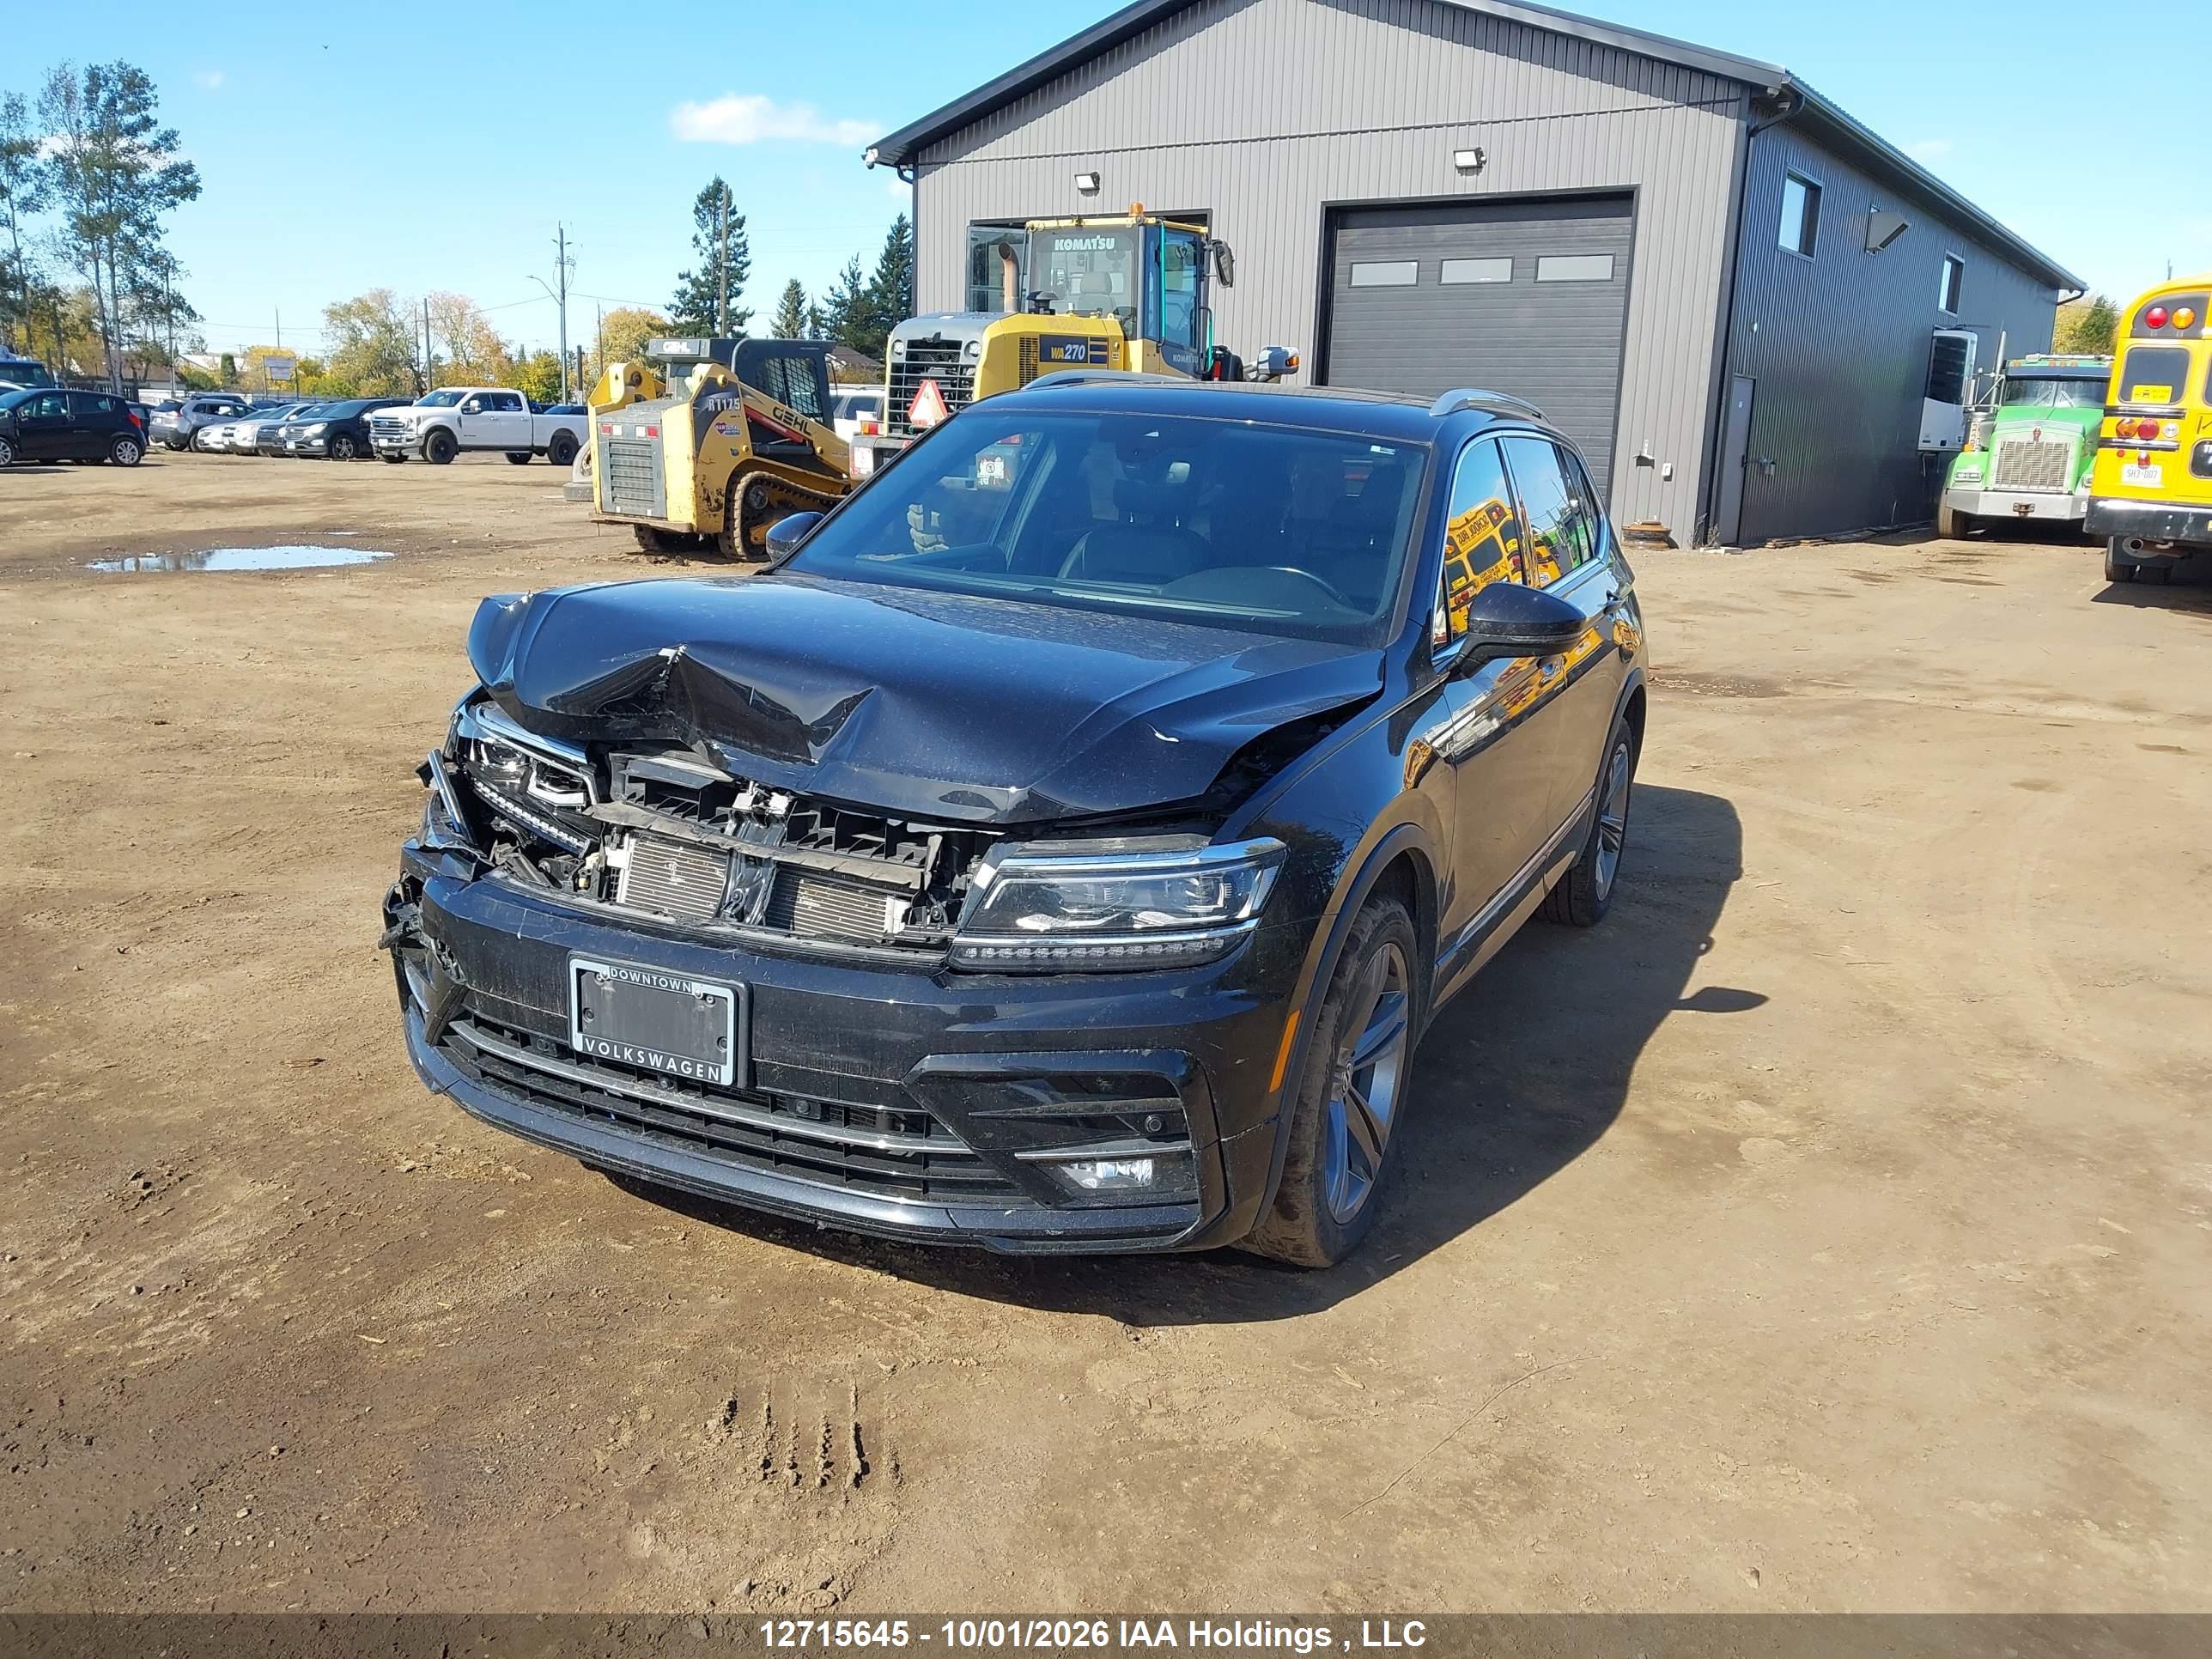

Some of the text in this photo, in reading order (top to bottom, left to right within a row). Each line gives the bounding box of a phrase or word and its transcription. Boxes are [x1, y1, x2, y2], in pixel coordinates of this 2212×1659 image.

[1054, 234, 1115, 251] KOMATSU
[1050, 343, 1086, 360] WA270
[773, 406, 812, 436] GEHL
[611, 968, 693, 993] DOWNTOWN
[585, 1037, 720, 1082] VOLKSWAGEN
